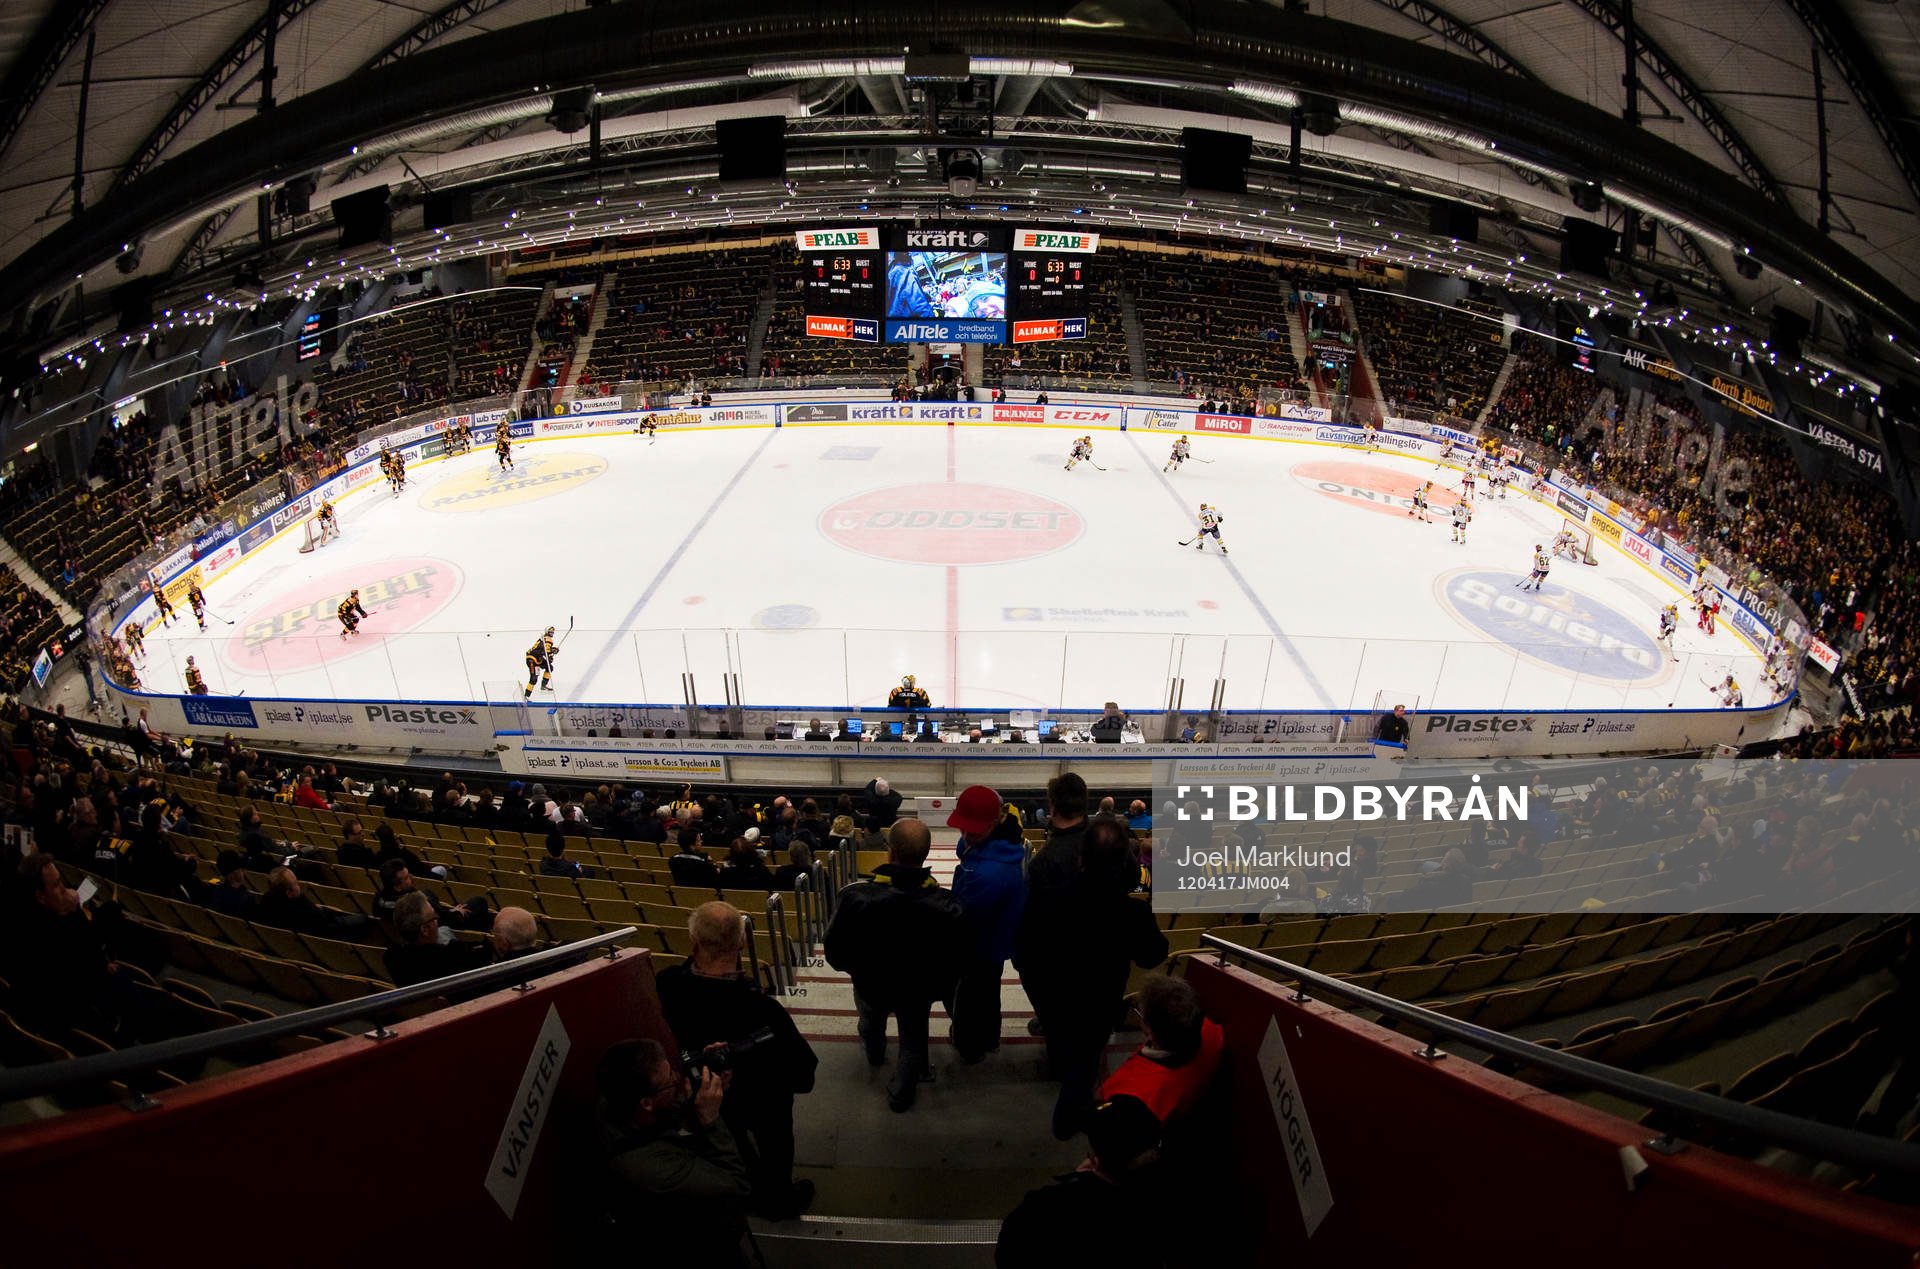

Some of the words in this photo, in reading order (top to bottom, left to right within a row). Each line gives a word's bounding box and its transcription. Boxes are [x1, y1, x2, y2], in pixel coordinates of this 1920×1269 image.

[813, 232, 859, 246] PEAB
[907, 231, 967, 247] kraft
[1035, 234, 1081, 249] PEAB
[810, 322, 846, 332] ALIMAK
[854, 325, 874, 335] HEK
[894, 324, 949, 339] AllTele
[1018, 326, 1056, 336] ALIMAK
[1064, 324, 1082, 333] HEK
[1624, 348, 1647, 370] AIK
[584, 400, 620, 409] KUUSAKOSKI
[852, 407, 897, 419] kraft
[920, 407, 965, 419] kraft
[994, 409, 1044, 419] FRANKE
[1054, 410, 1111, 422] CCM
[595, 418, 639, 427] INTERSPORT
[1431, 426, 1475, 446] FUMEX
[349, 464, 375, 482] REPAY
[432, 465, 603, 508] RAMIRENT
[274, 496, 311, 526] GUIDE
[863, 510, 1070, 530] ODDSET
[1591, 515, 1621, 539] engcon
[1624, 537, 1651, 561] JULA
[243, 566, 438, 647] SPORT
[1143, 608, 1190, 618] Kraft
[1742, 590, 1785, 628] PROFIX
[265, 709, 294, 723] iplast
[309, 711, 354, 724] iplast.se
[364, 704, 479, 726] Plastex
[571, 711, 608, 730] iplast
[630, 711, 686, 729] iplast.se
[1220, 721, 1258, 737] iplast
[1282, 721, 1334, 736] iplast.se
[1425, 715, 1536, 733] Plastex
[1548, 720, 1580, 737] iplast
[1595, 721, 1635, 735] iplast.se
[527, 756, 557, 768] iplast
[575, 758, 620, 770] iplast.se
[624, 757, 652, 766] Larsson
[653, 758, 660, 766] &
[661, 758, 678, 767] Co:s
[680, 758, 708, 769] Tryckeri
[710, 760, 721, 768] AB
[1179, 763, 1209, 772] Larsson
[1210, 764, 1217, 772] &
[1218, 763, 1235, 772] Co:s
[1237, 763, 1265, 773] Tryckeri
[1265, 763, 1276, 771] AB
[1279, 764, 1310, 777] iplast
[1329, 764, 1370, 775] iplast.se
[807, 958, 825, 968] V8
[788, 987, 808, 997] V9
[501, 1039, 559, 1179] VÄNSTER
[1272, 1065, 1313, 1187] HÖGER
